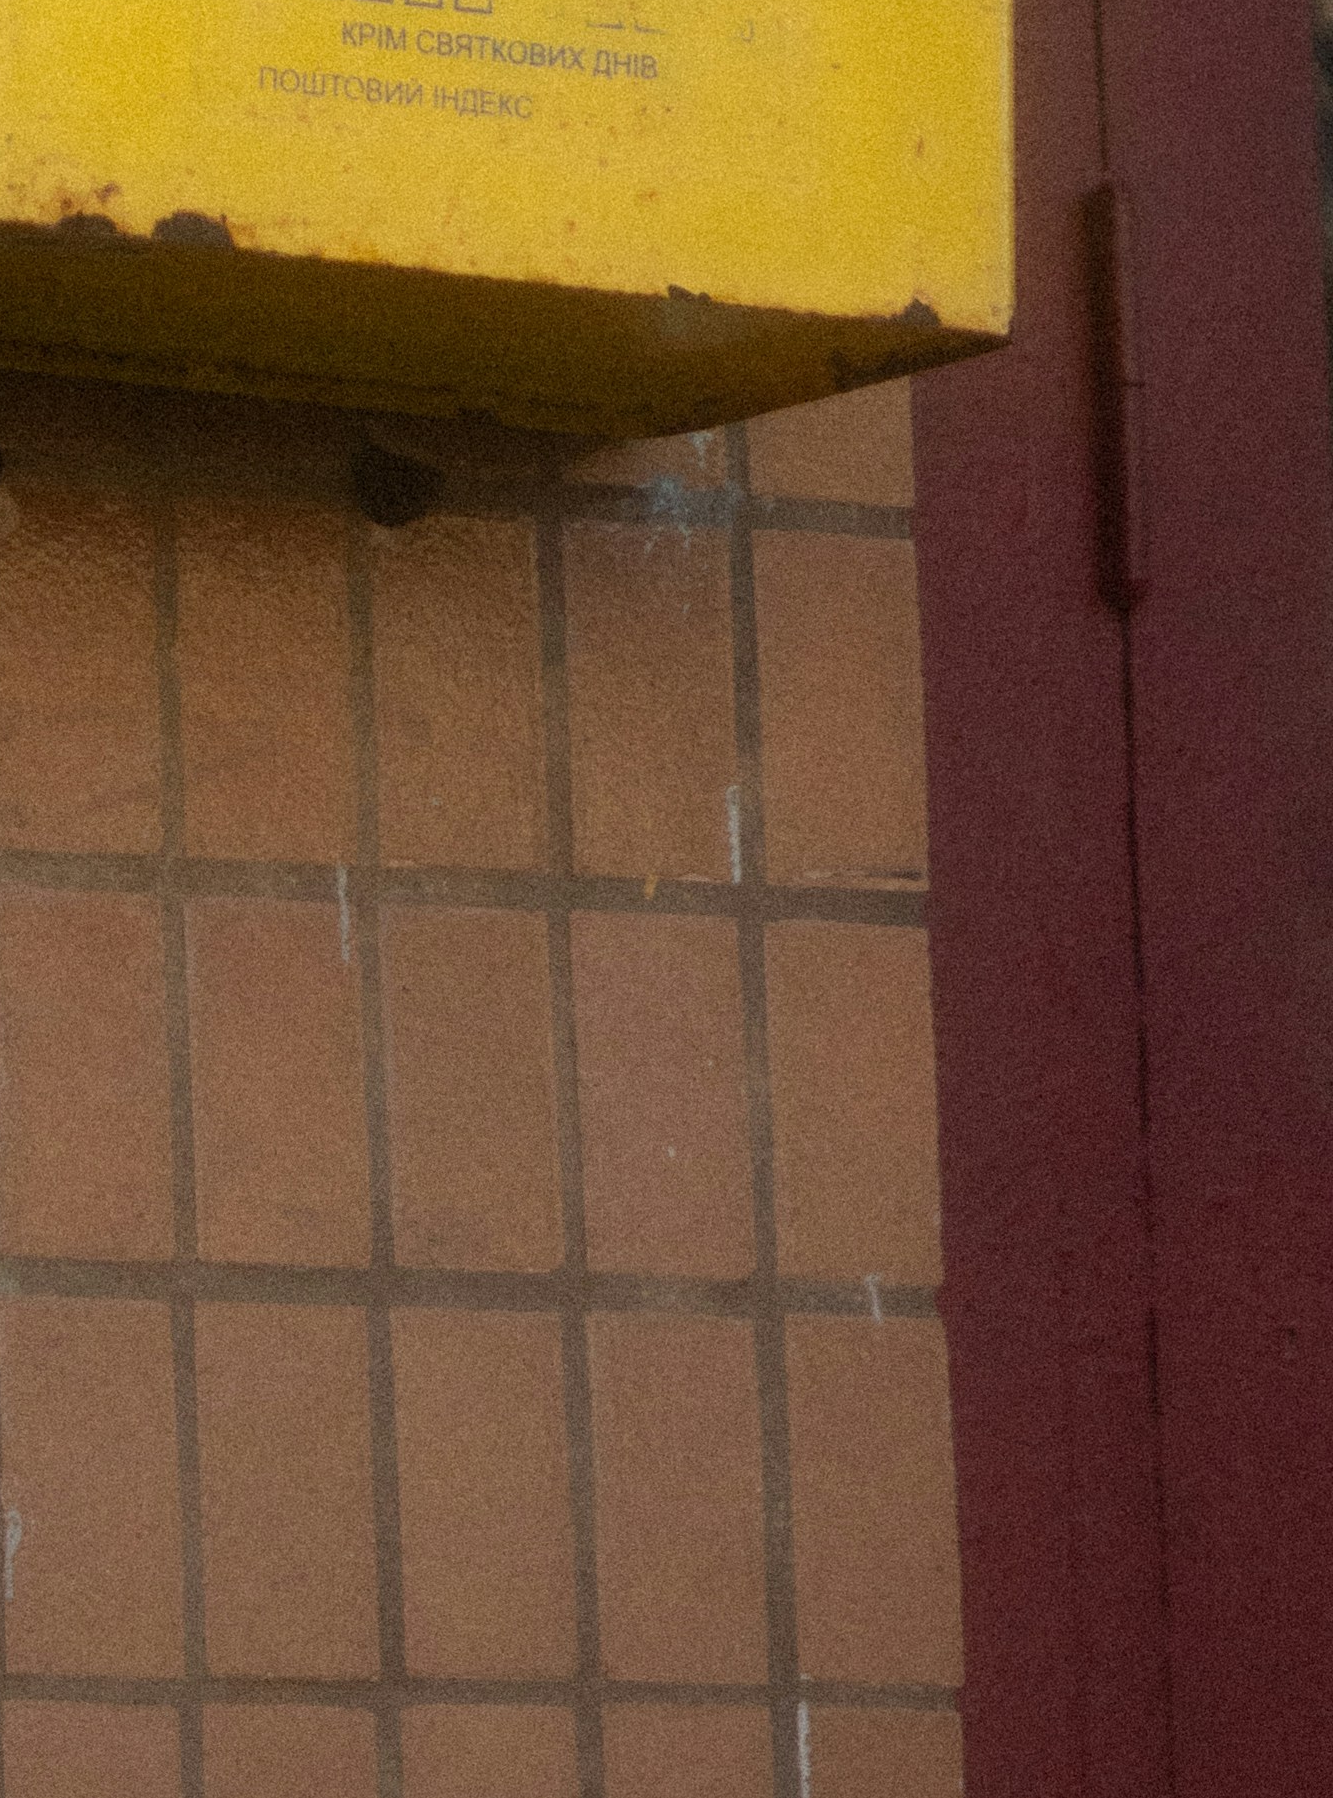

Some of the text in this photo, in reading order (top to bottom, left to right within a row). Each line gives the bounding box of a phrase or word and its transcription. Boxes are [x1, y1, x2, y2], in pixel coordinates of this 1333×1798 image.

[341, 20, 659, 82] КРІМ СВЯТКОВИХ ДНІВ
[258, 65, 534, 123] ПОШТОВИЙ ІНДЕКС
